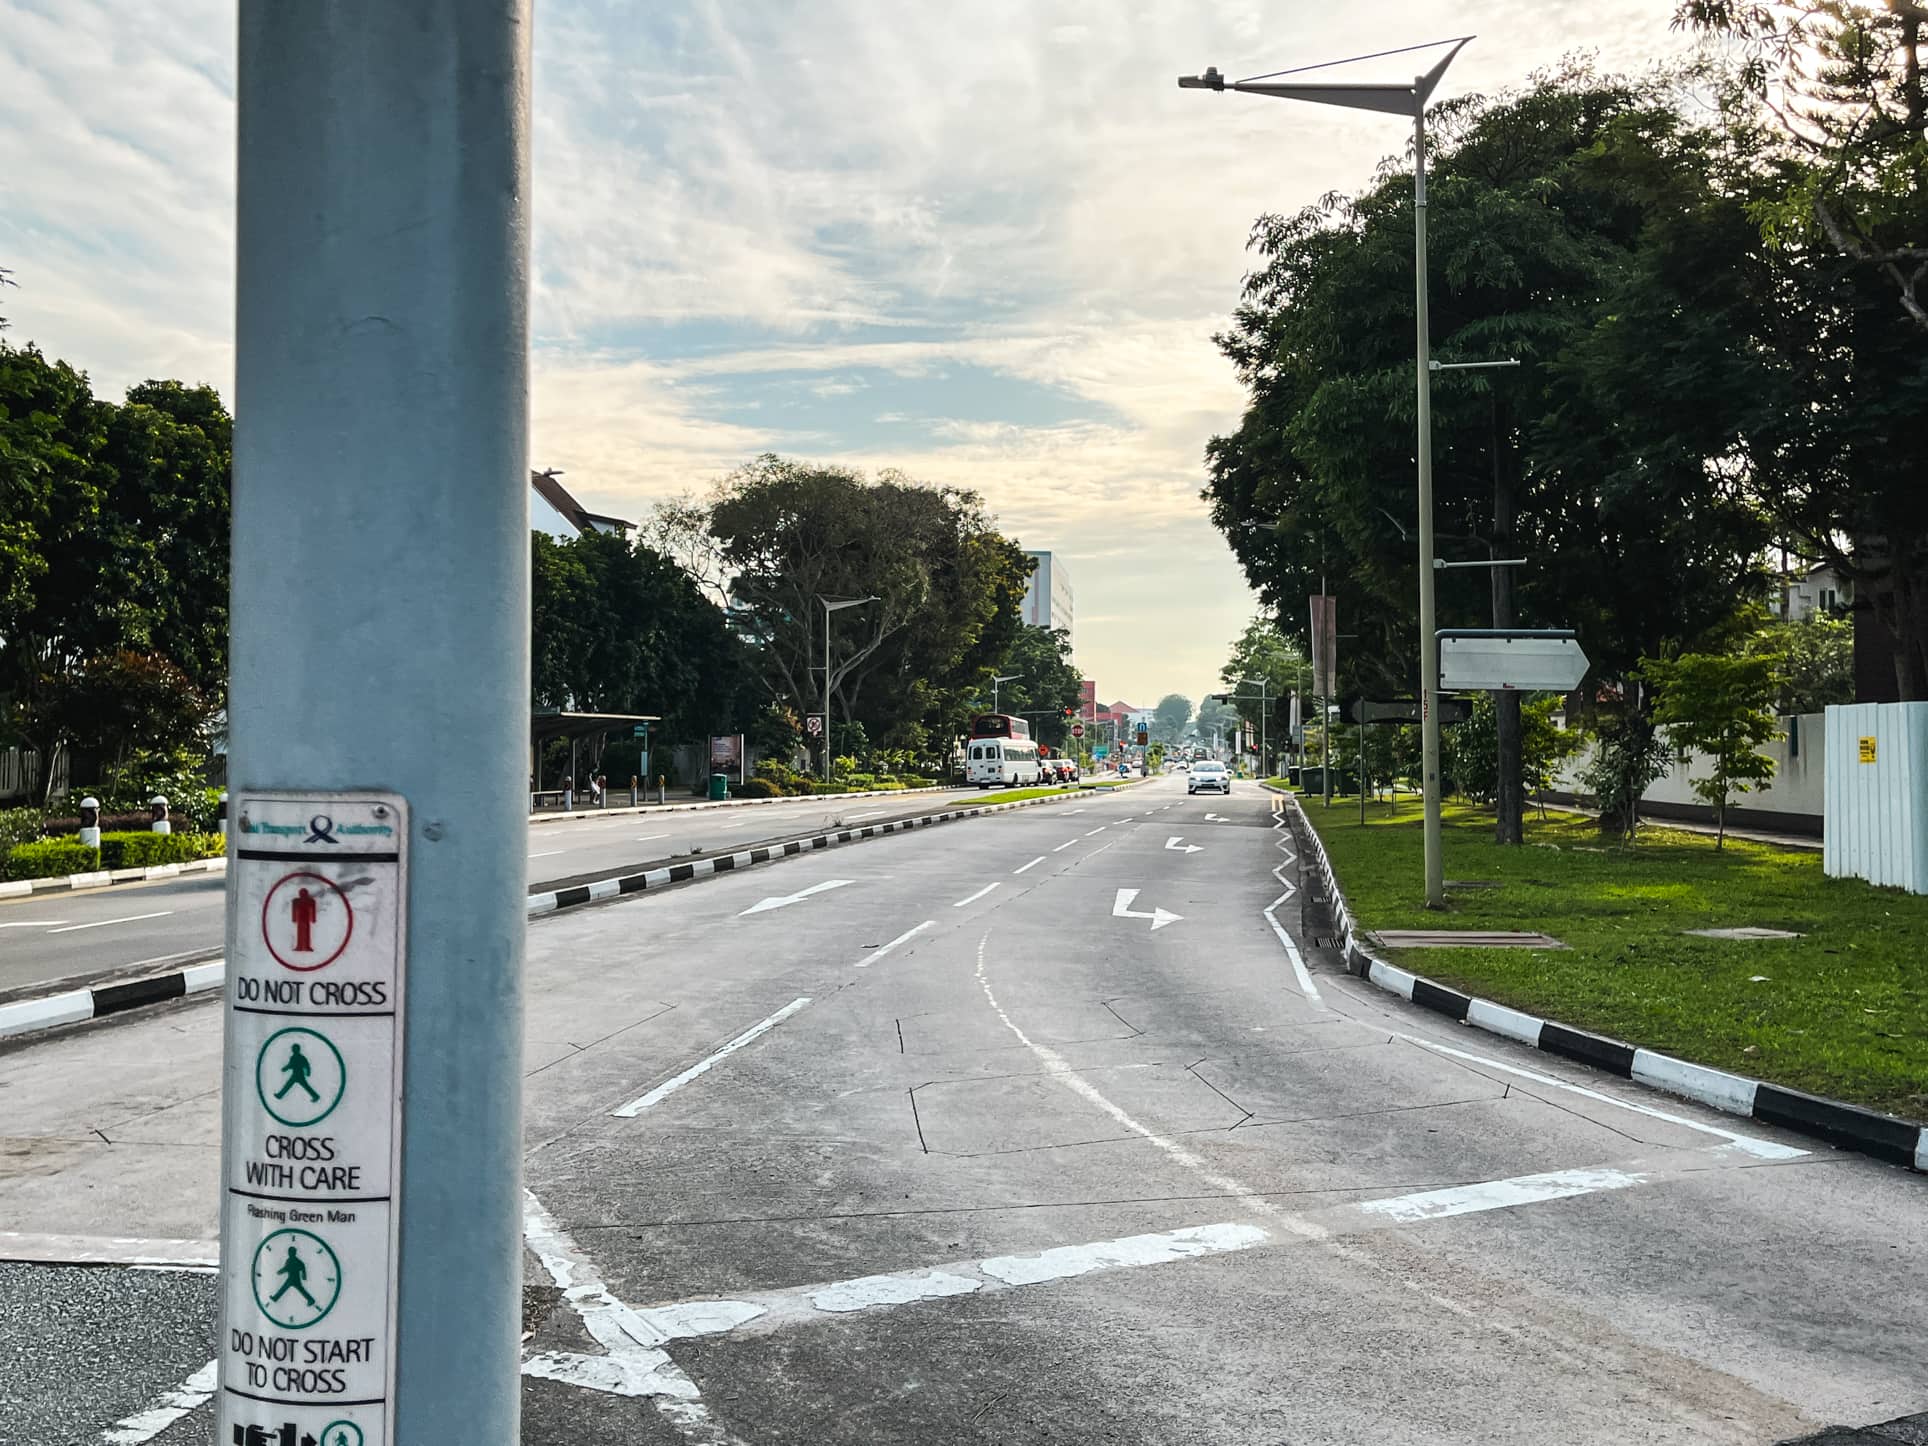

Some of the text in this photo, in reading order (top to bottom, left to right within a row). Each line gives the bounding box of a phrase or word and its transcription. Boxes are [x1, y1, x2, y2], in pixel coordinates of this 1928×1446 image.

[238, 977, 386, 1005] DO NOT CROSS
[265, 1135, 334, 1160] CROSS
[246, 1161, 360, 1190] WITH CARE
[248, 1204, 355, 1224] Flashing Green Man
[232, 1329, 375, 1364] DO NOT START
[246, 1362, 346, 1393] TO CROSS
